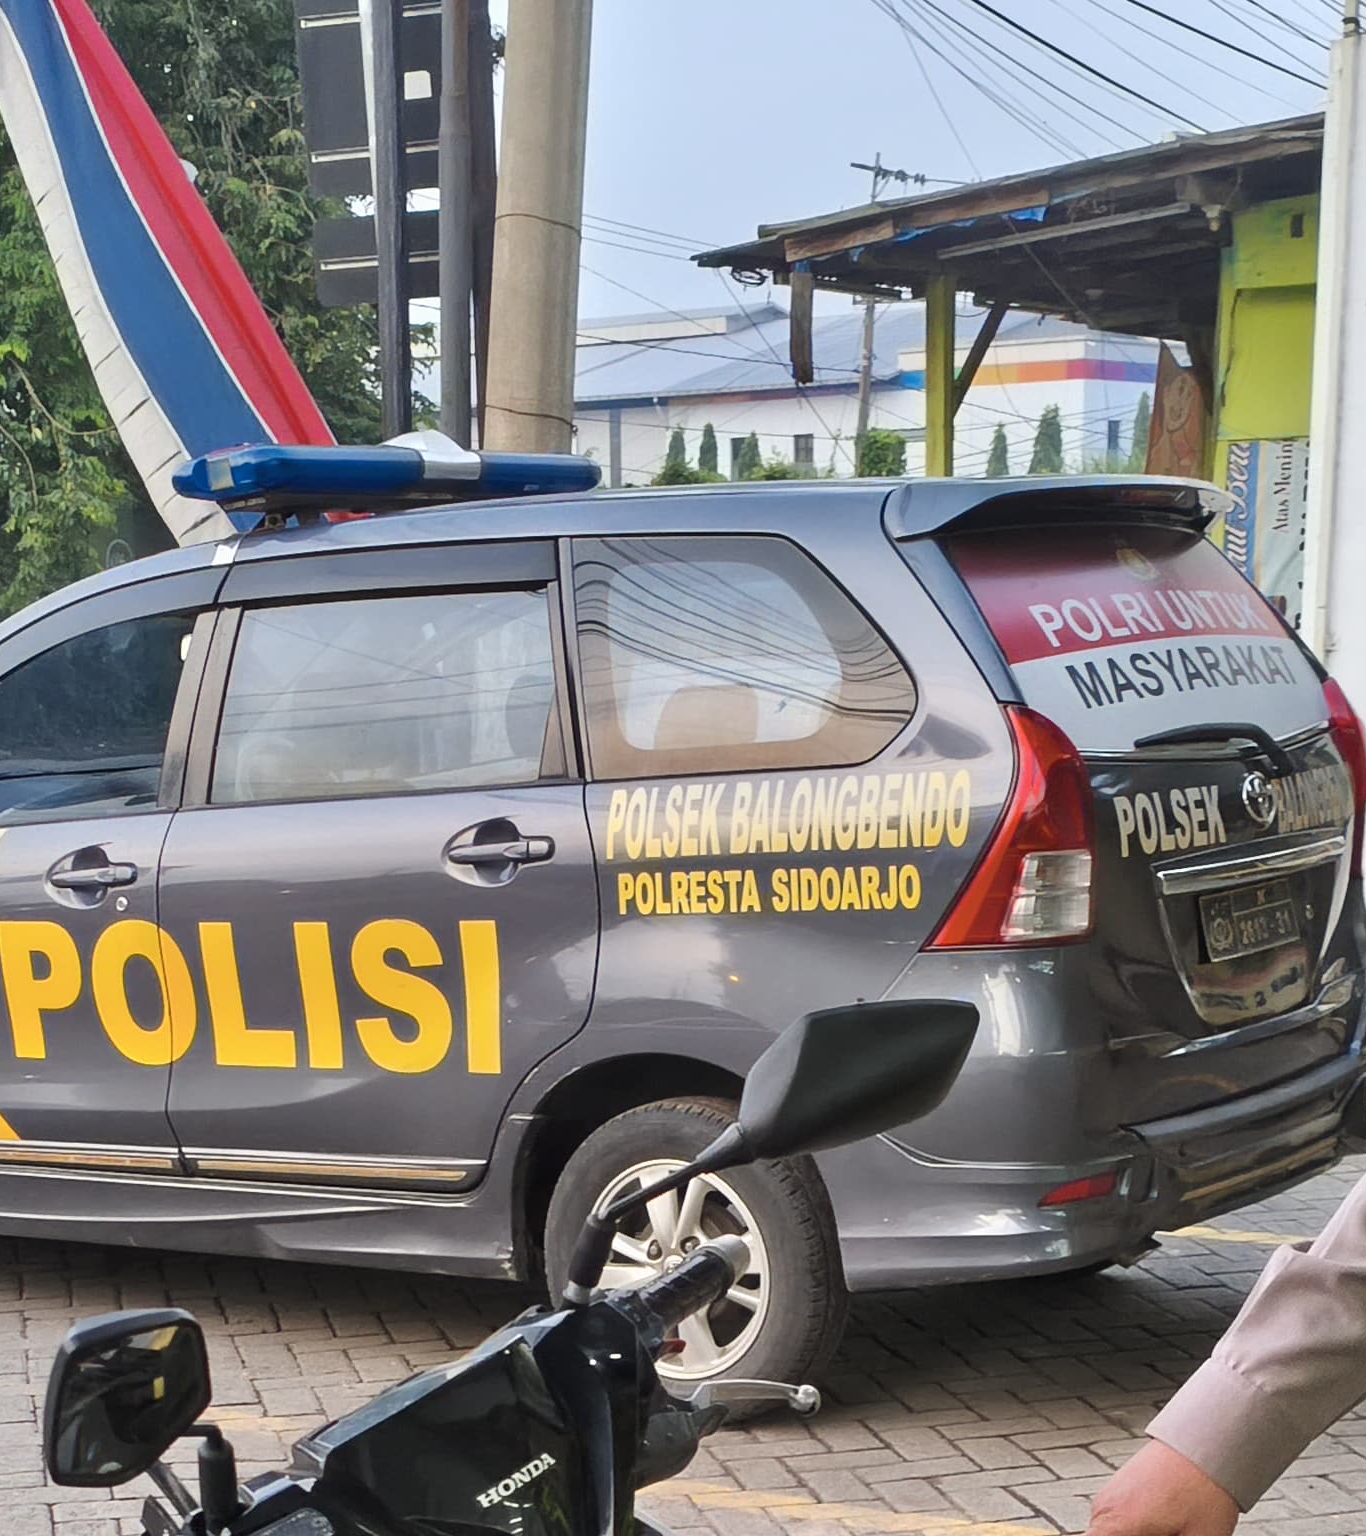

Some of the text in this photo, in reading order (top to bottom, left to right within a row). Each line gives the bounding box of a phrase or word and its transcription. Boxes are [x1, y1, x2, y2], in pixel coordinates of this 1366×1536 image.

[1272, 440, 1295, 533] Atas Menin
[1028, 589, 1268, 648] POLRI UNTUK
[1065, 645, 1297, 709] MASYARAKAT
[606, 769, 971, 860] POLSEK BALONGBENDO
[1113, 785, 1227, 858] POLSEK
[618, 864, 922, 916] POLRESTA SIDOARJO
[476, 1453, 556, 1508] HONDA
